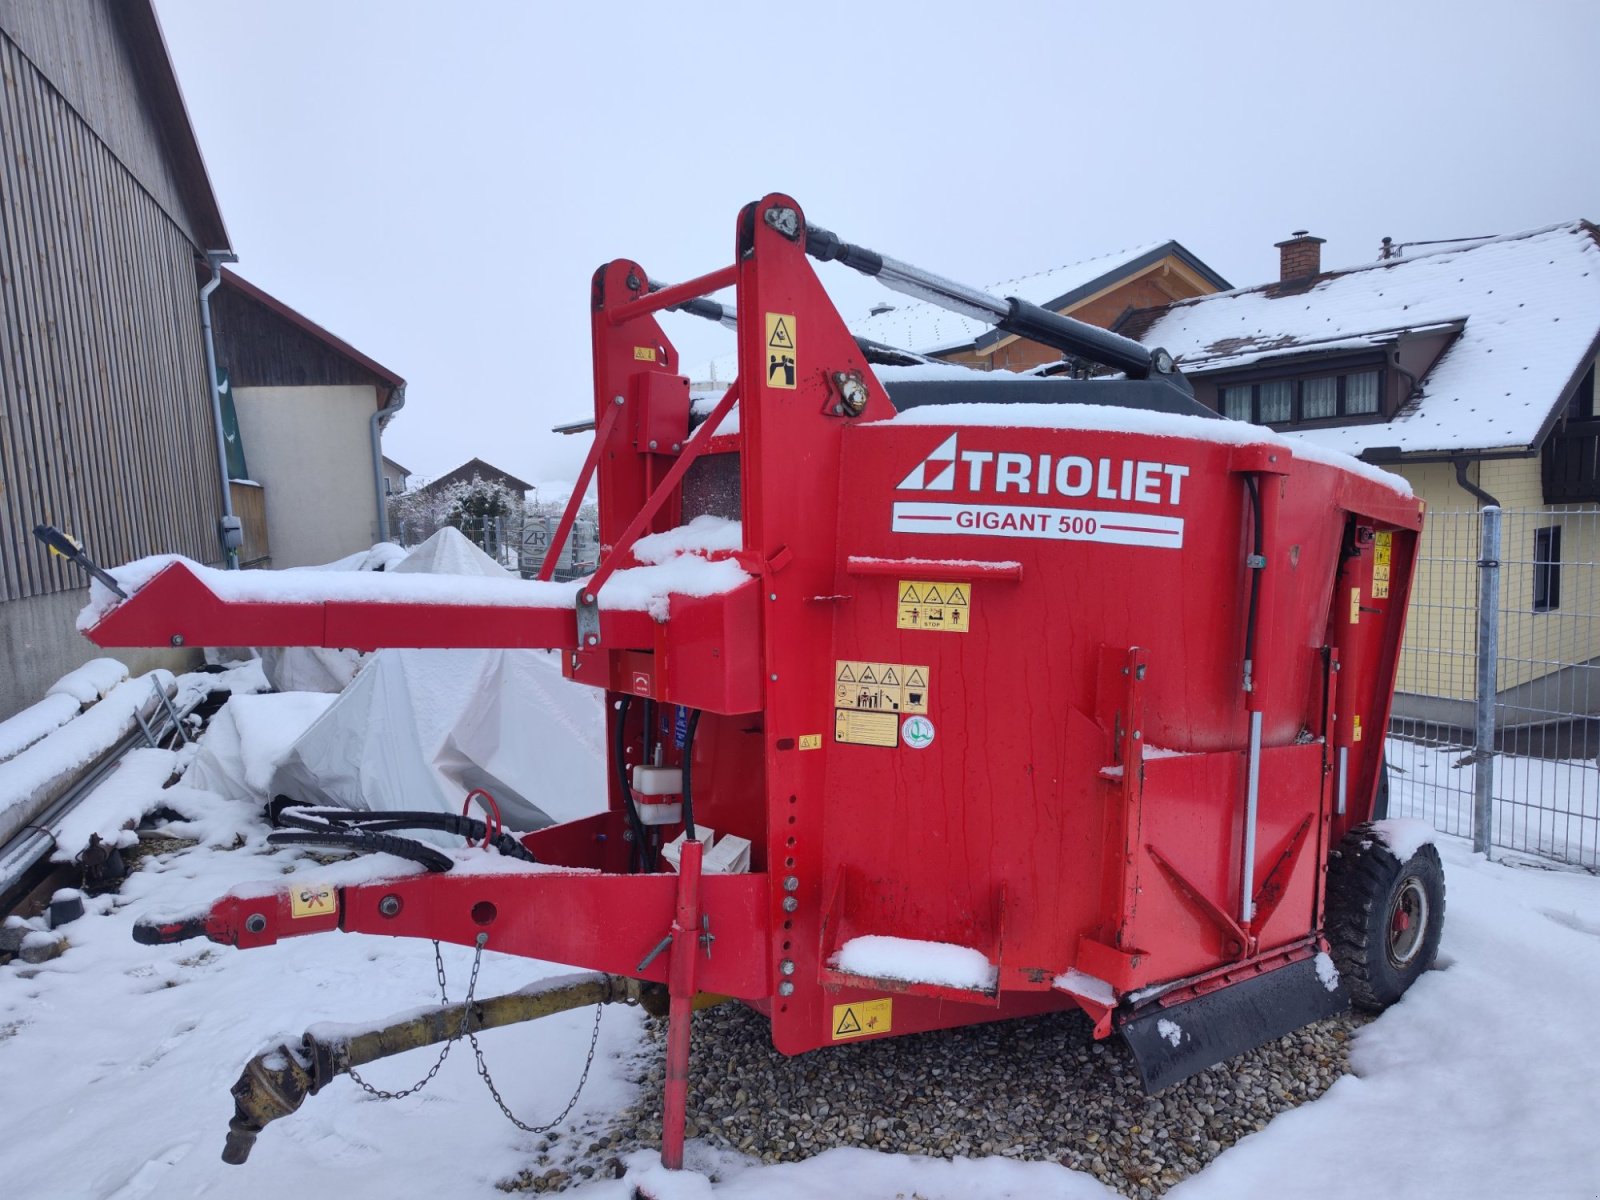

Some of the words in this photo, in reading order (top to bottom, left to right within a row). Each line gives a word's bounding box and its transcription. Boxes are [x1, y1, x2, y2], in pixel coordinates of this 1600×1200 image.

[961, 450, 1190, 505] TRIOLIET
[956, 511, 1052, 532] GIGANT
[1058, 516, 1097, 535] 500
